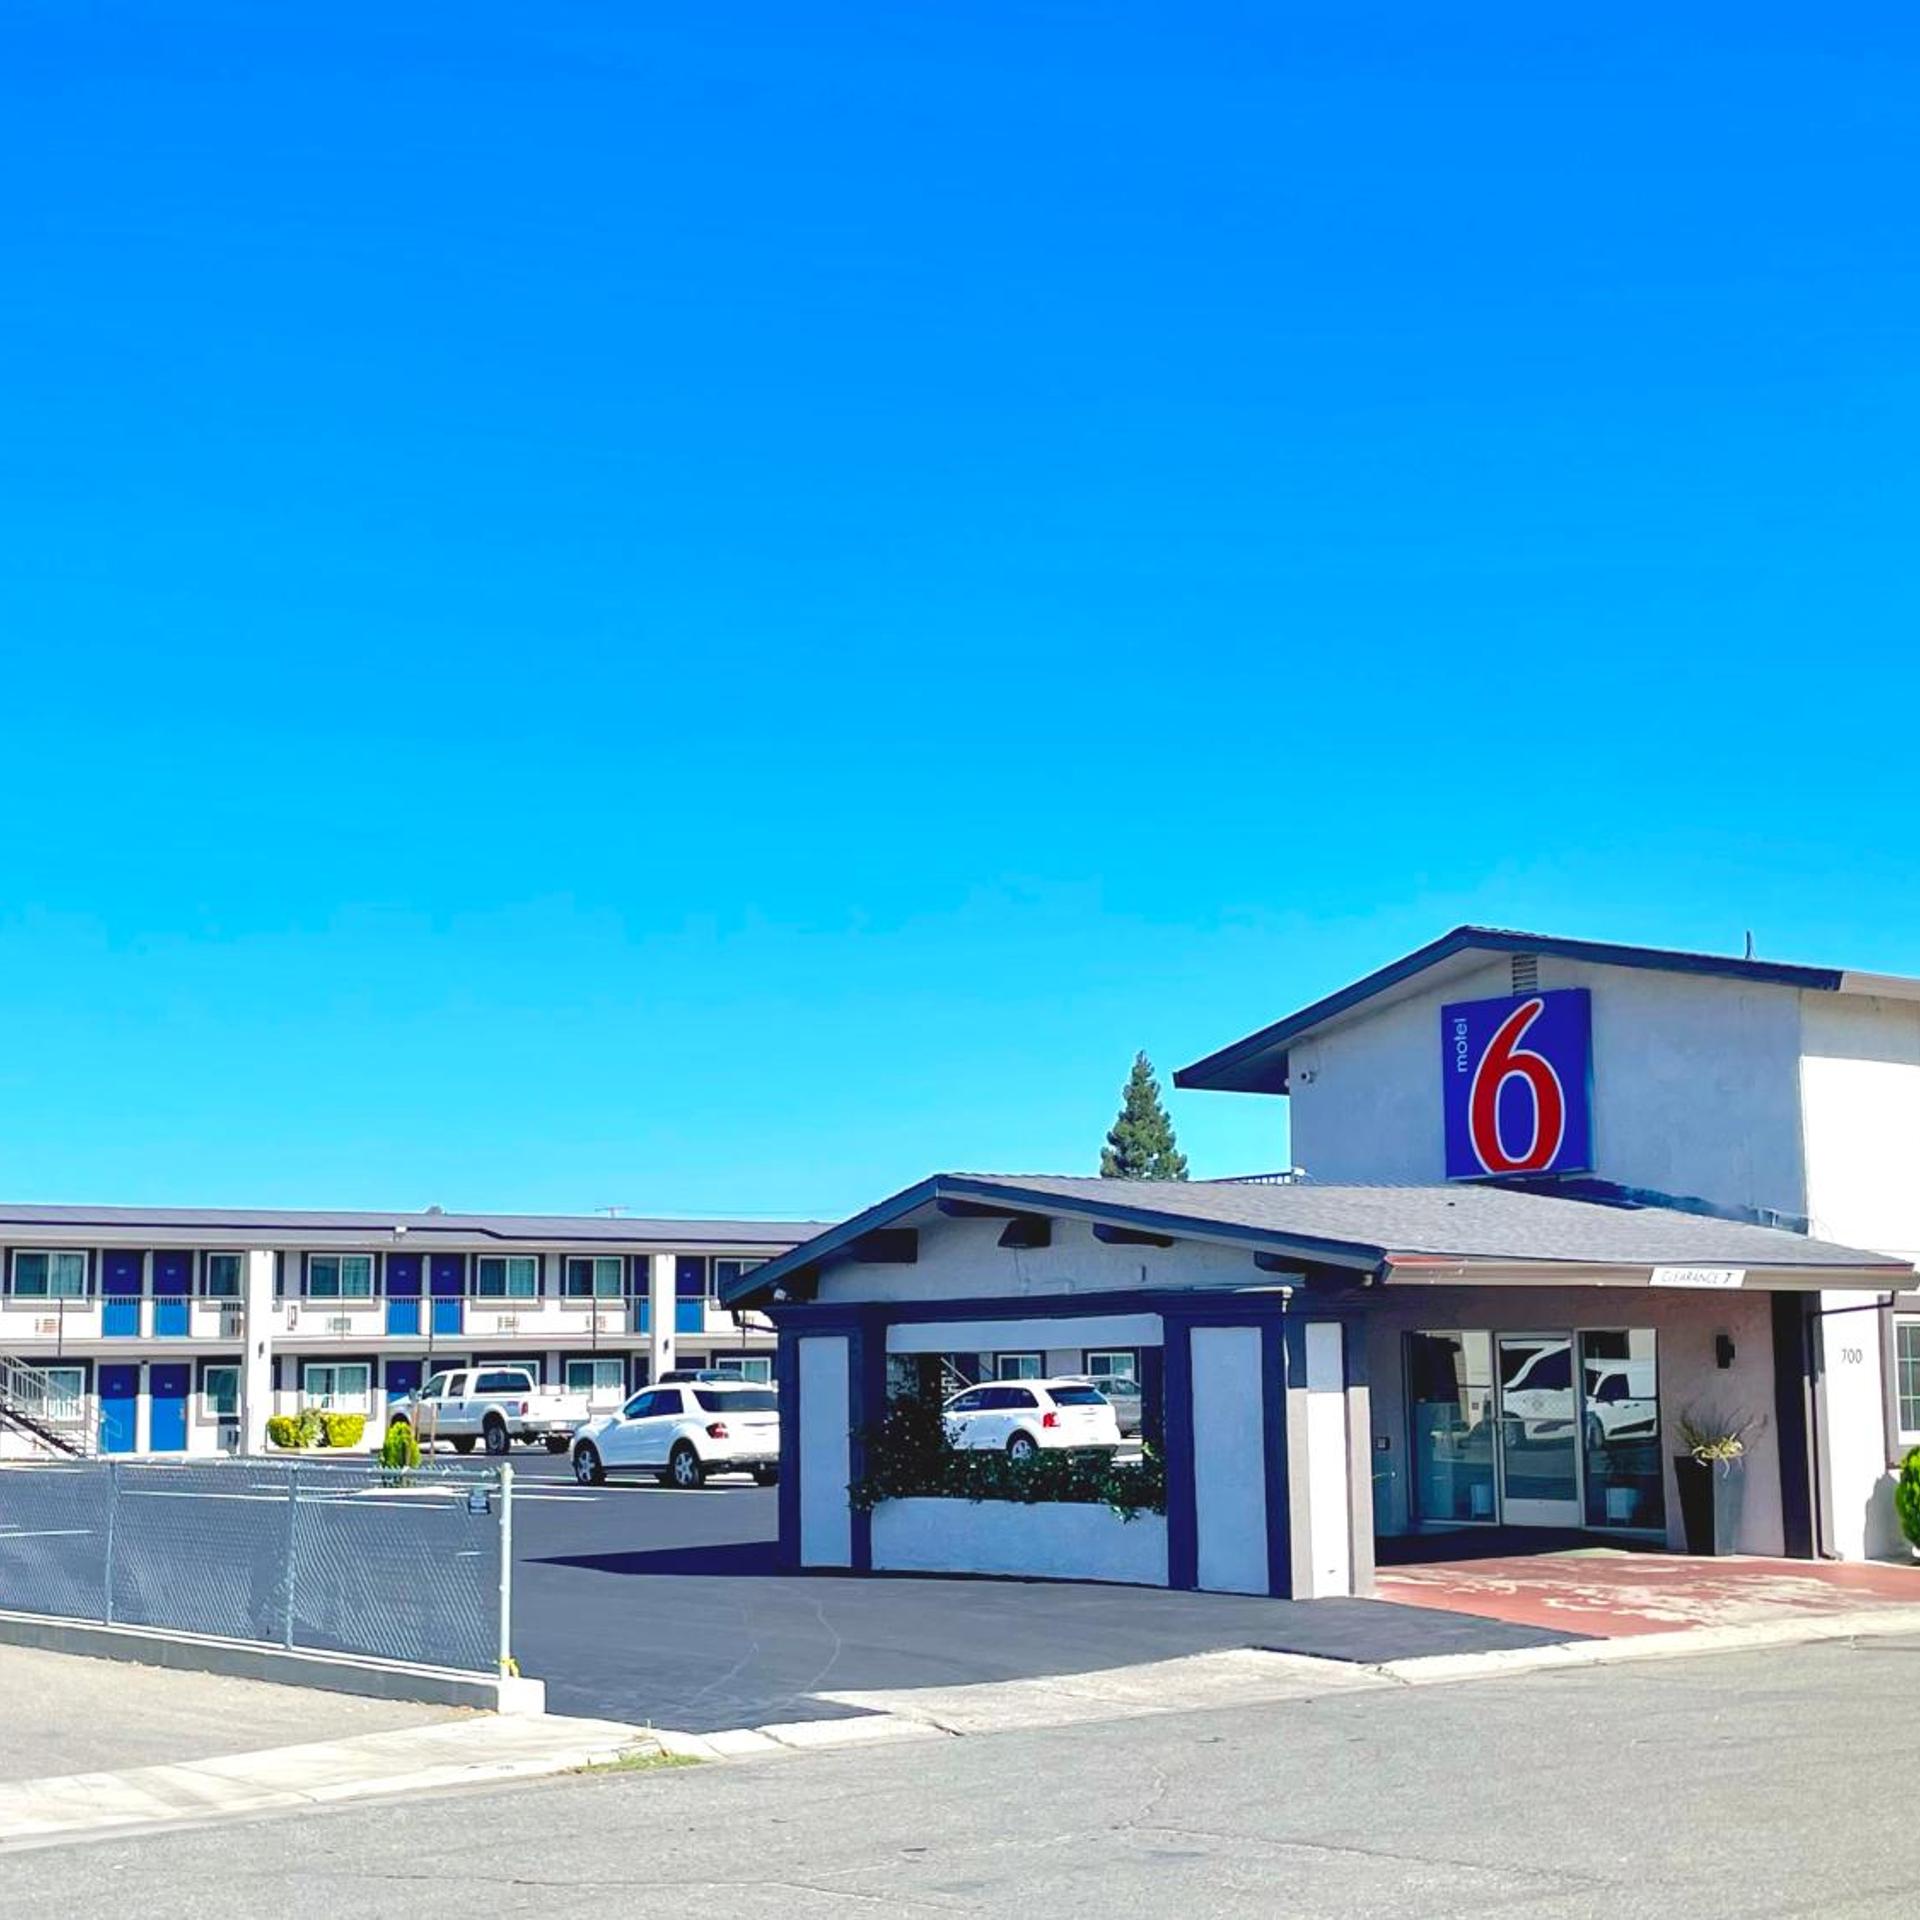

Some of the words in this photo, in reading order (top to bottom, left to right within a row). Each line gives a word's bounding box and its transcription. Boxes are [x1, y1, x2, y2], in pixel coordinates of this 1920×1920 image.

[1453, 1017, 1468, 1073] motel
[1468, 998, 1566, 1174] 6
[1841, 1348, 1863, 1364] 700
